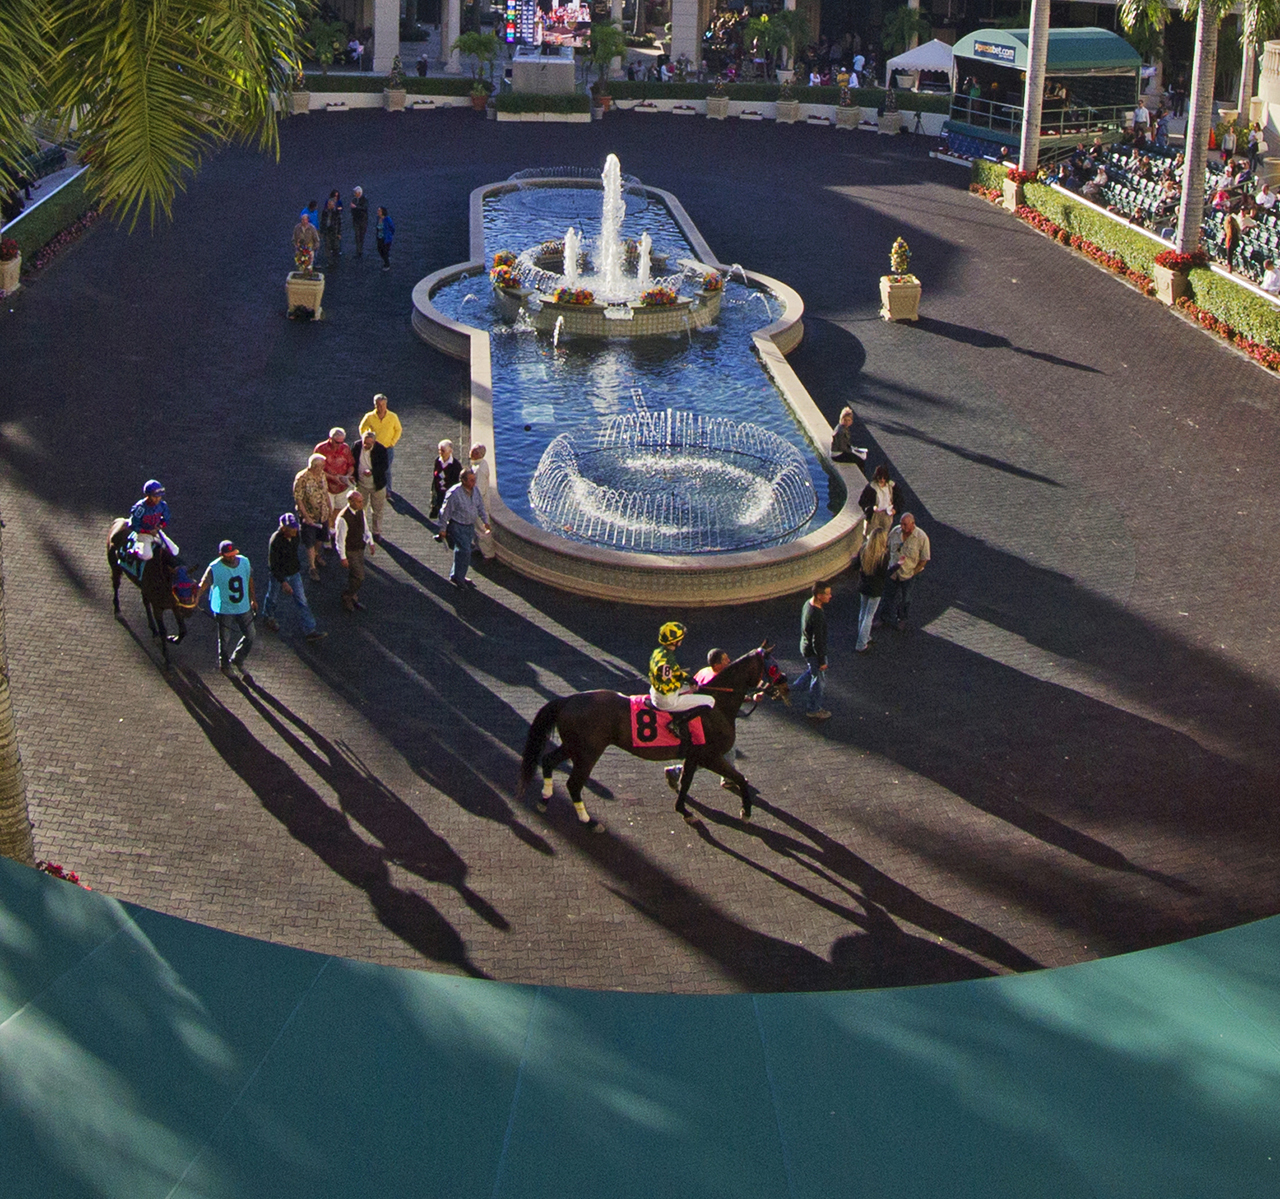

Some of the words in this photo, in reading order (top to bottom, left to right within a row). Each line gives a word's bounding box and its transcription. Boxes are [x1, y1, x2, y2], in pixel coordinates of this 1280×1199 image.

[228, 575, 245, 604] 9
[664, 665, 671, 677] 8
[636, 708, 658, 743] 8
